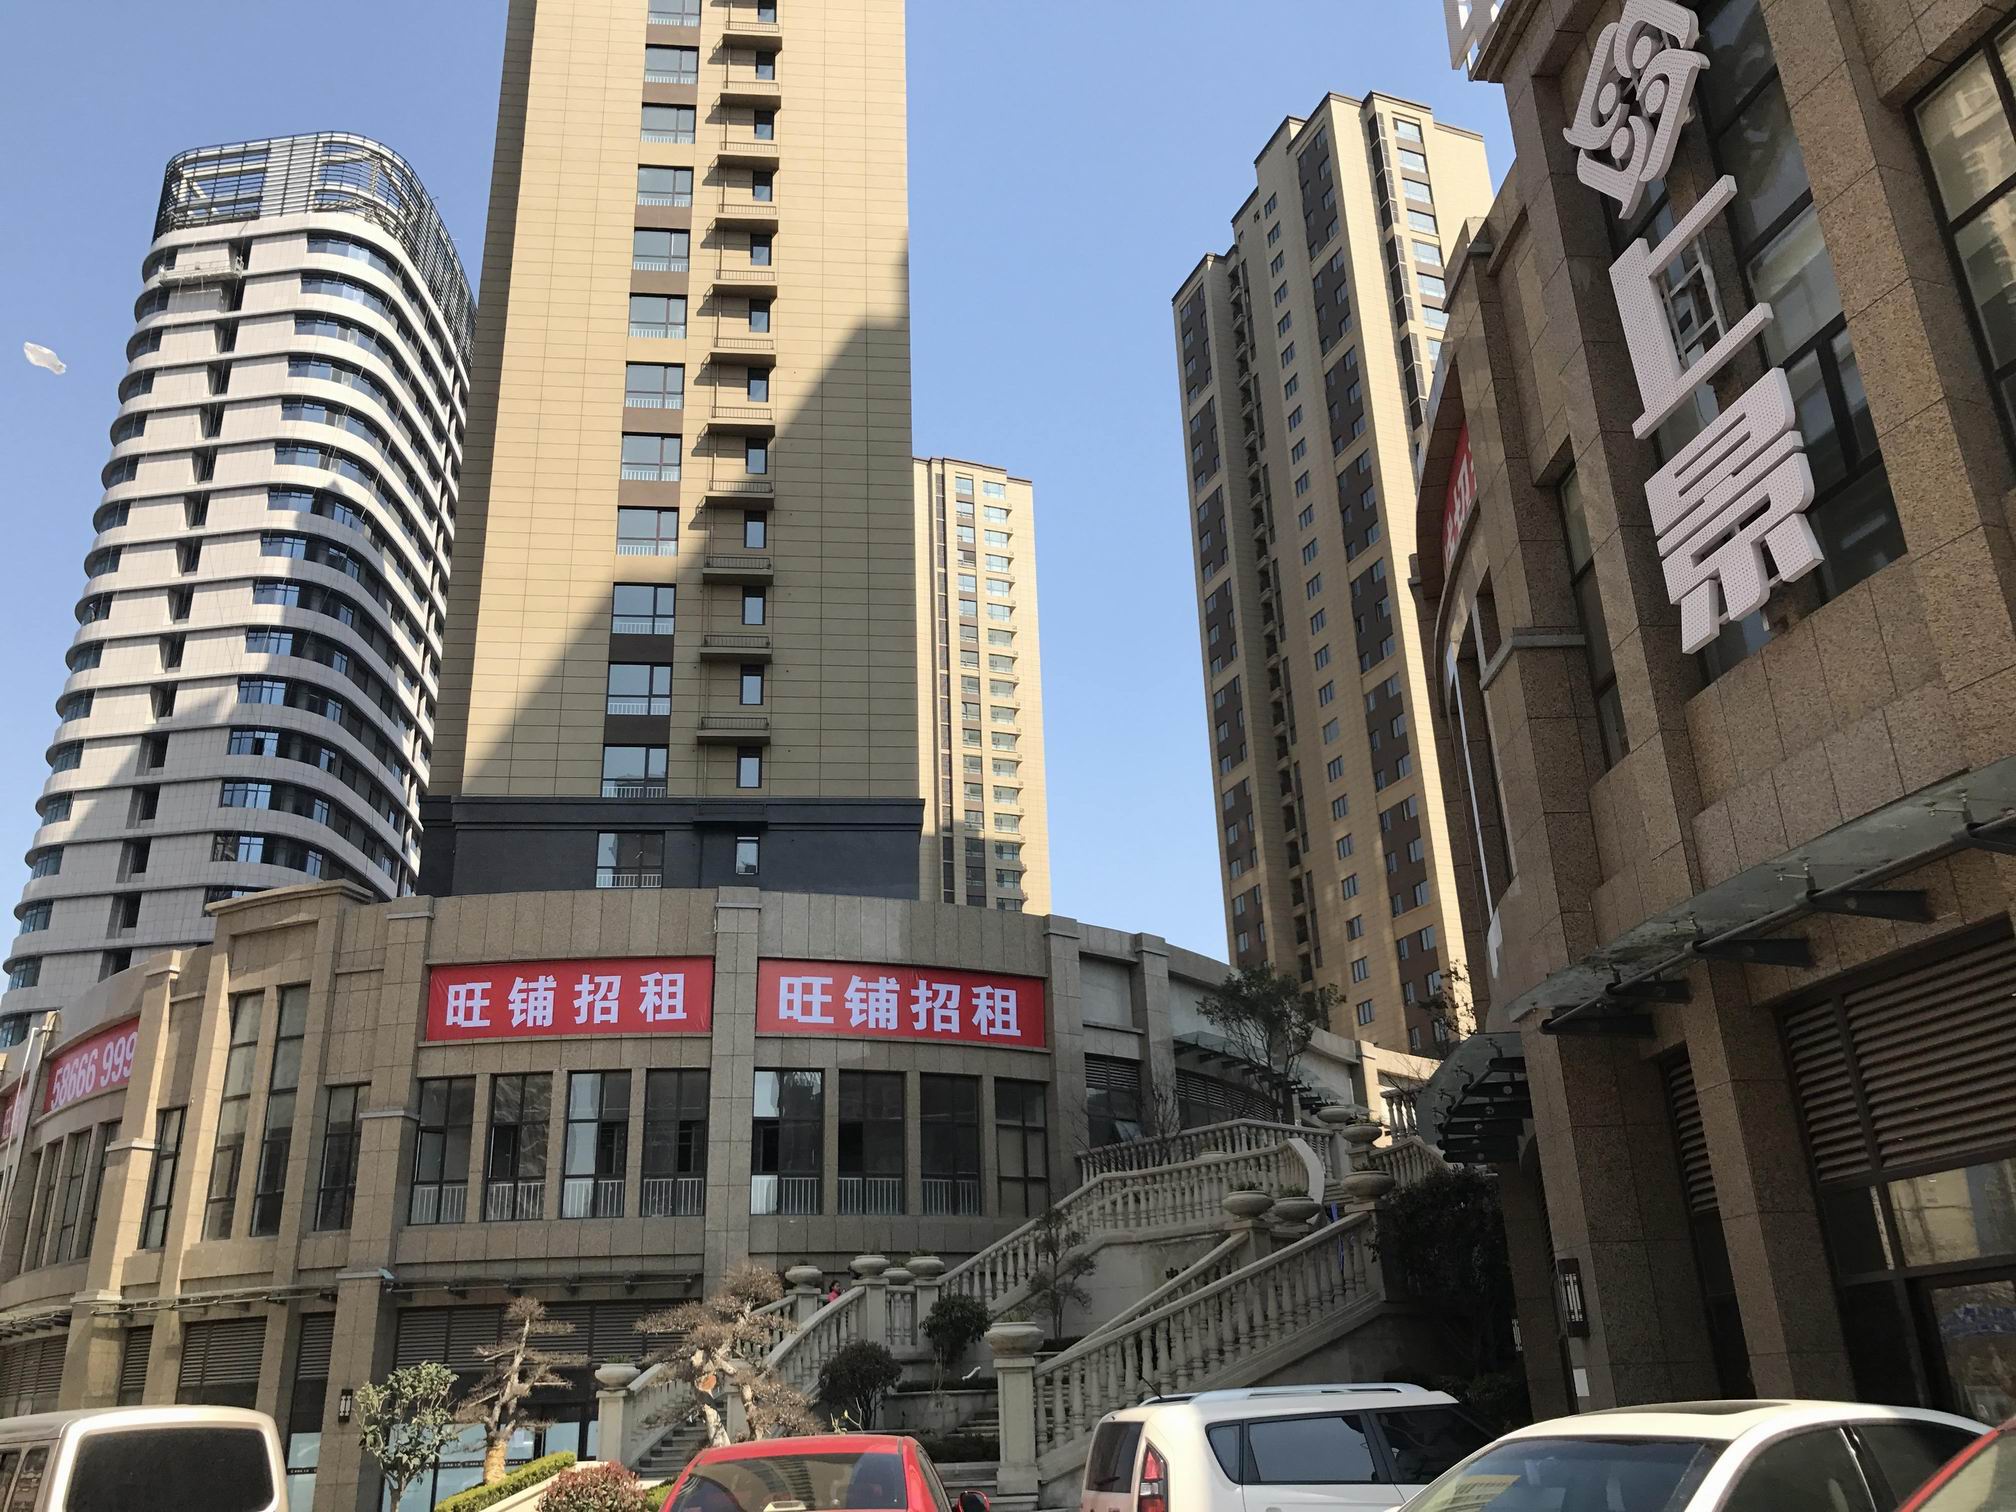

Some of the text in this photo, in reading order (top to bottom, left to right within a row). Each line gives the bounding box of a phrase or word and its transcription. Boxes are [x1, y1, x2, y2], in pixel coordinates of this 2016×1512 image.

[446, 972, 687, 1028] 旺铺招租
[778, 975, 1022, 1036] 旺铺招租
[50, 1048, 98, 1111] 58666
